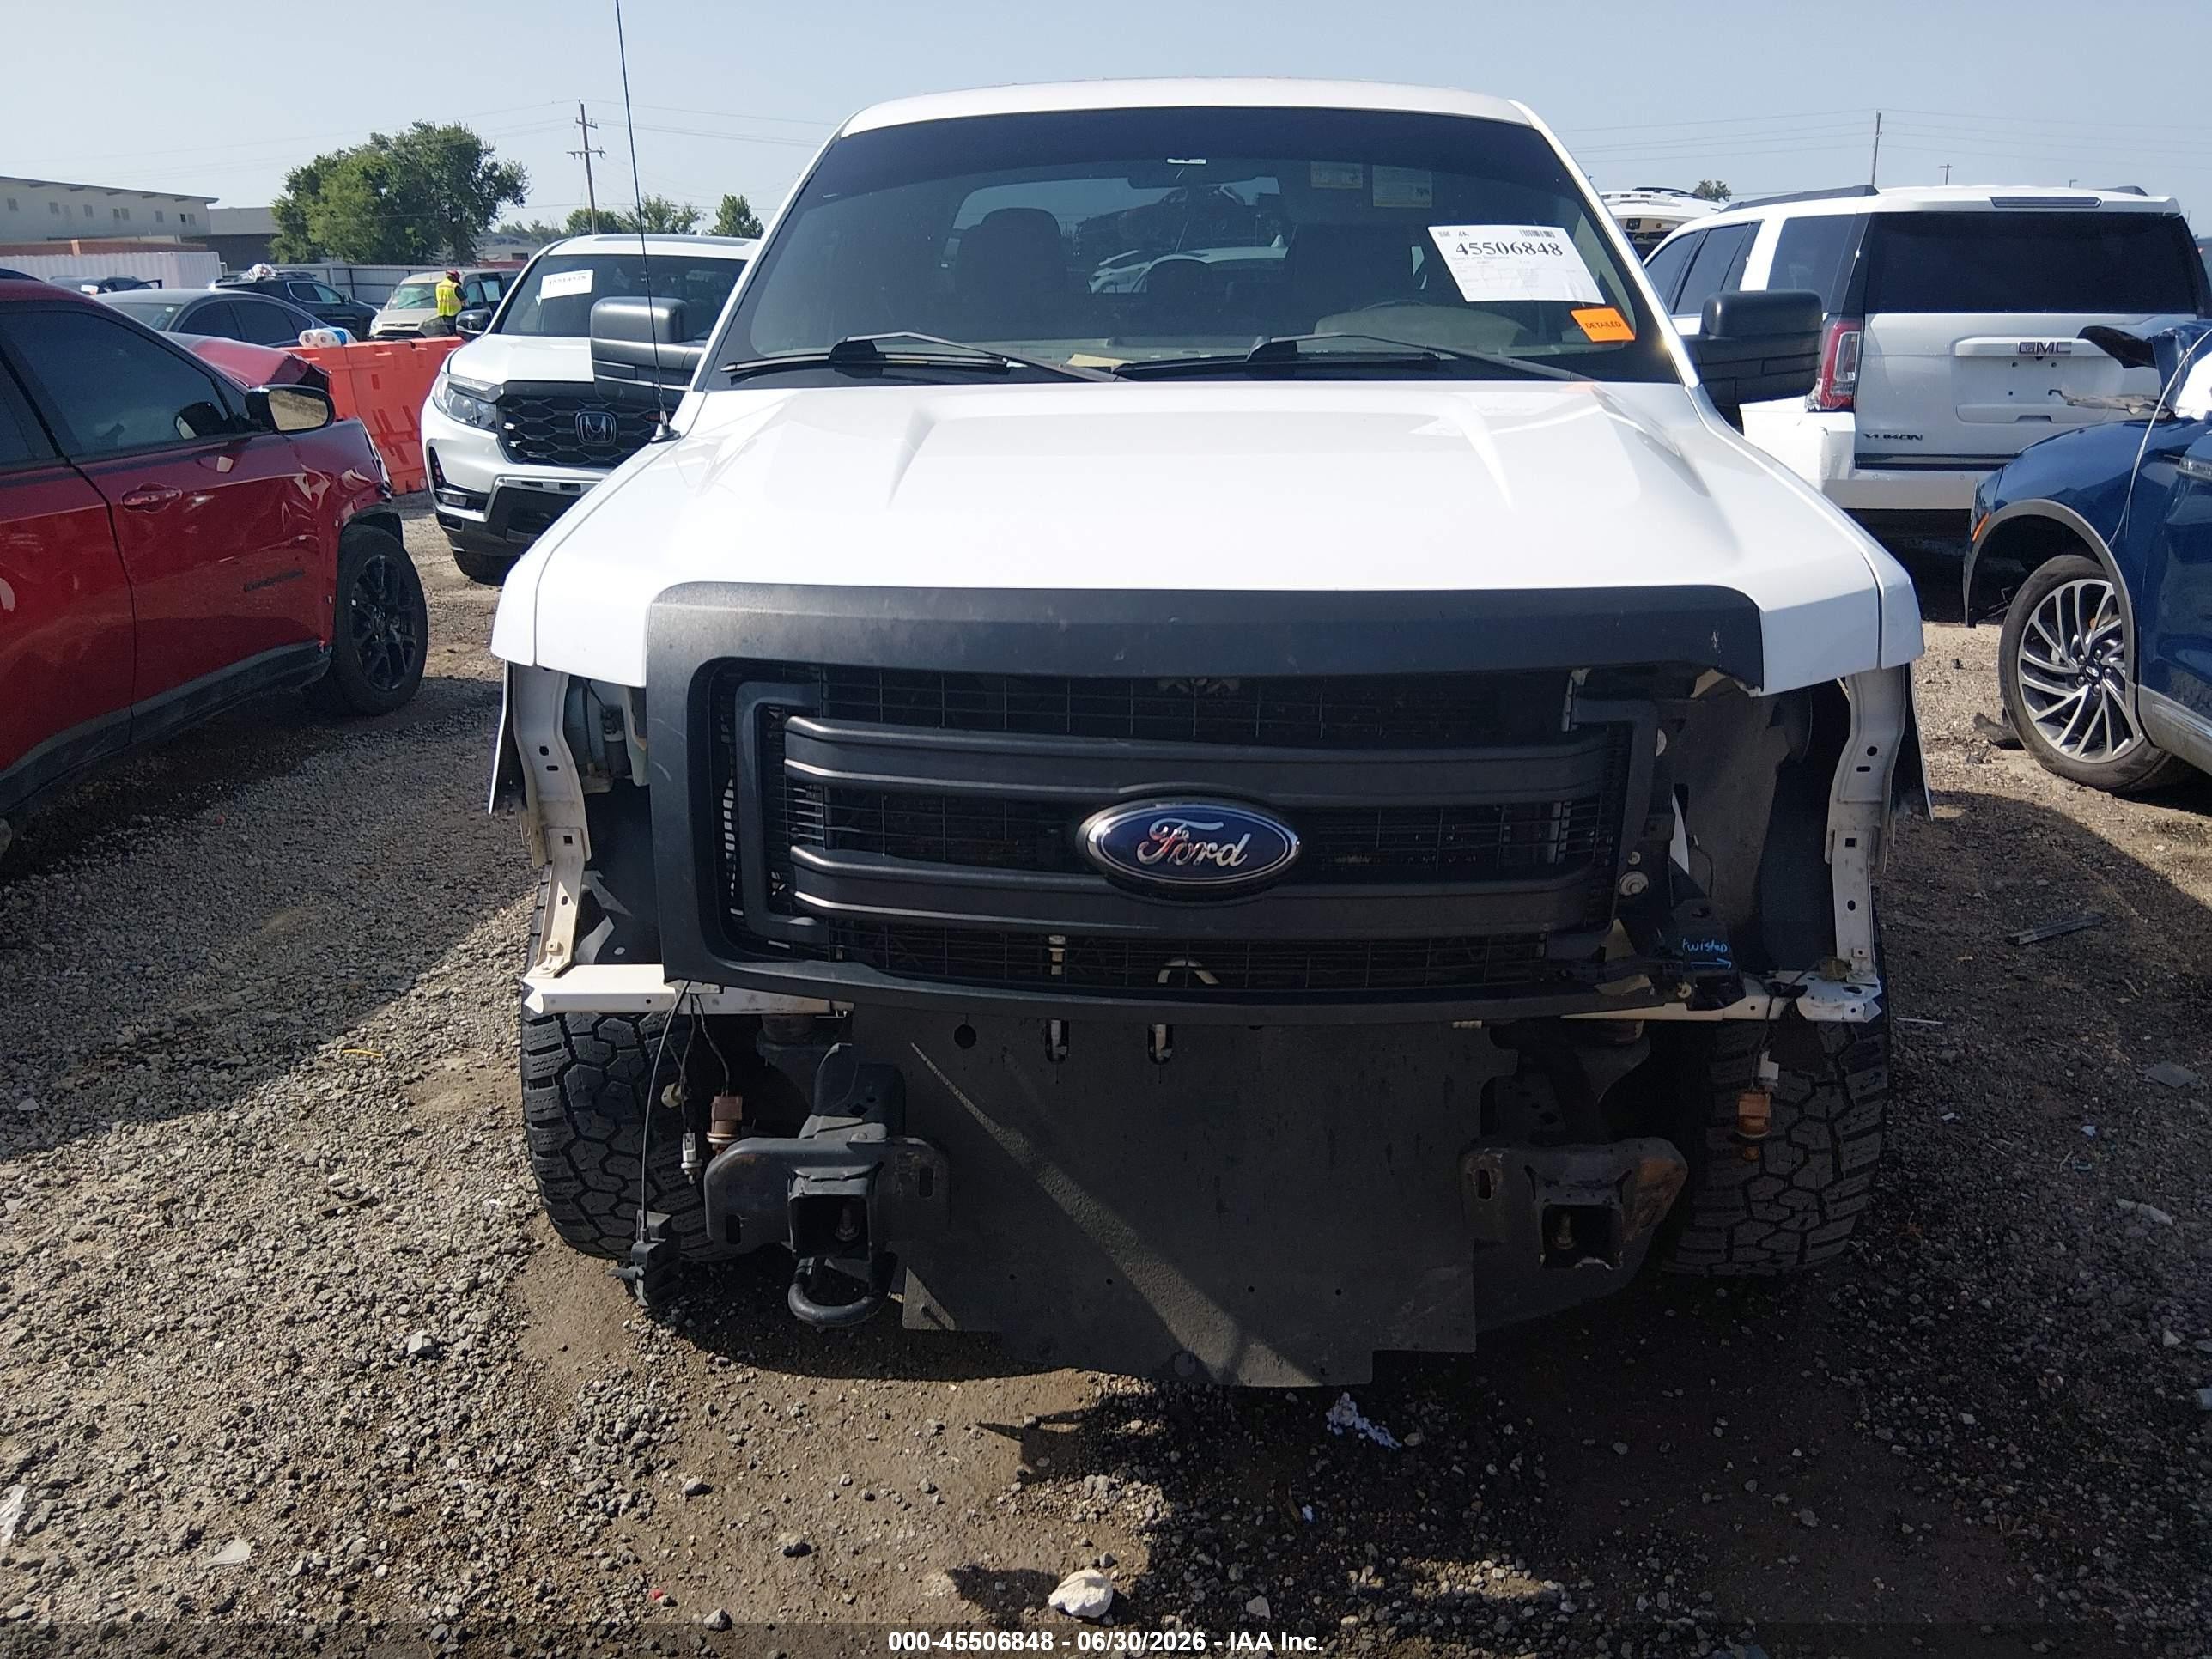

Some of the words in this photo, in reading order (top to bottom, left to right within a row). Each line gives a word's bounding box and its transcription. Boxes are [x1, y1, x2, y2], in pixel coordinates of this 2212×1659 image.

[1455, 241, 1563, 256] 45506848
[1584, 320, 1622, 329] DETAILED
[2019, 342, 2072, 354] GMC
[1137, 817, 1251, 867] Ford
